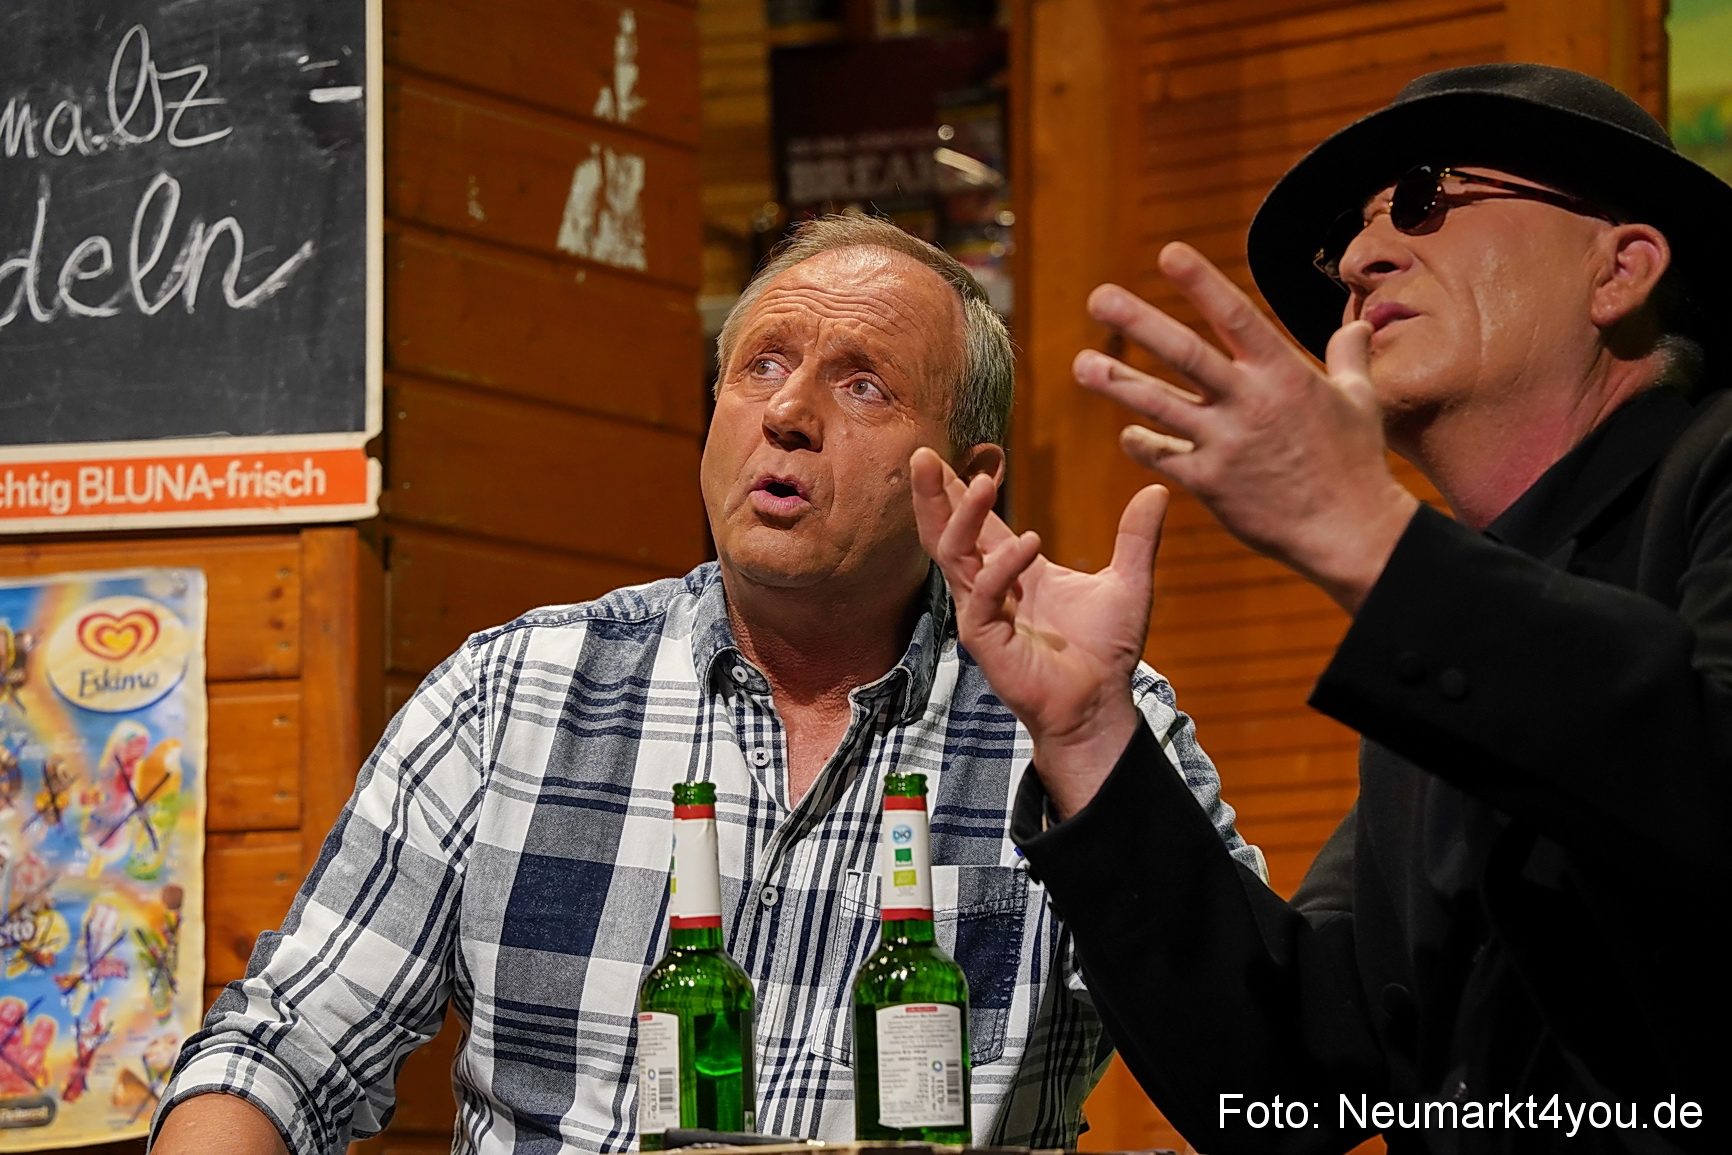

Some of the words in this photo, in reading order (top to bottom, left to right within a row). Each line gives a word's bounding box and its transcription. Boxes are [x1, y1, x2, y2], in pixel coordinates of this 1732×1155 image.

[0, 470, 72, 515] htig
[78, 457, 327, 506] BLUNA-frisch
[79, 667, 160, 698] Eskimo
